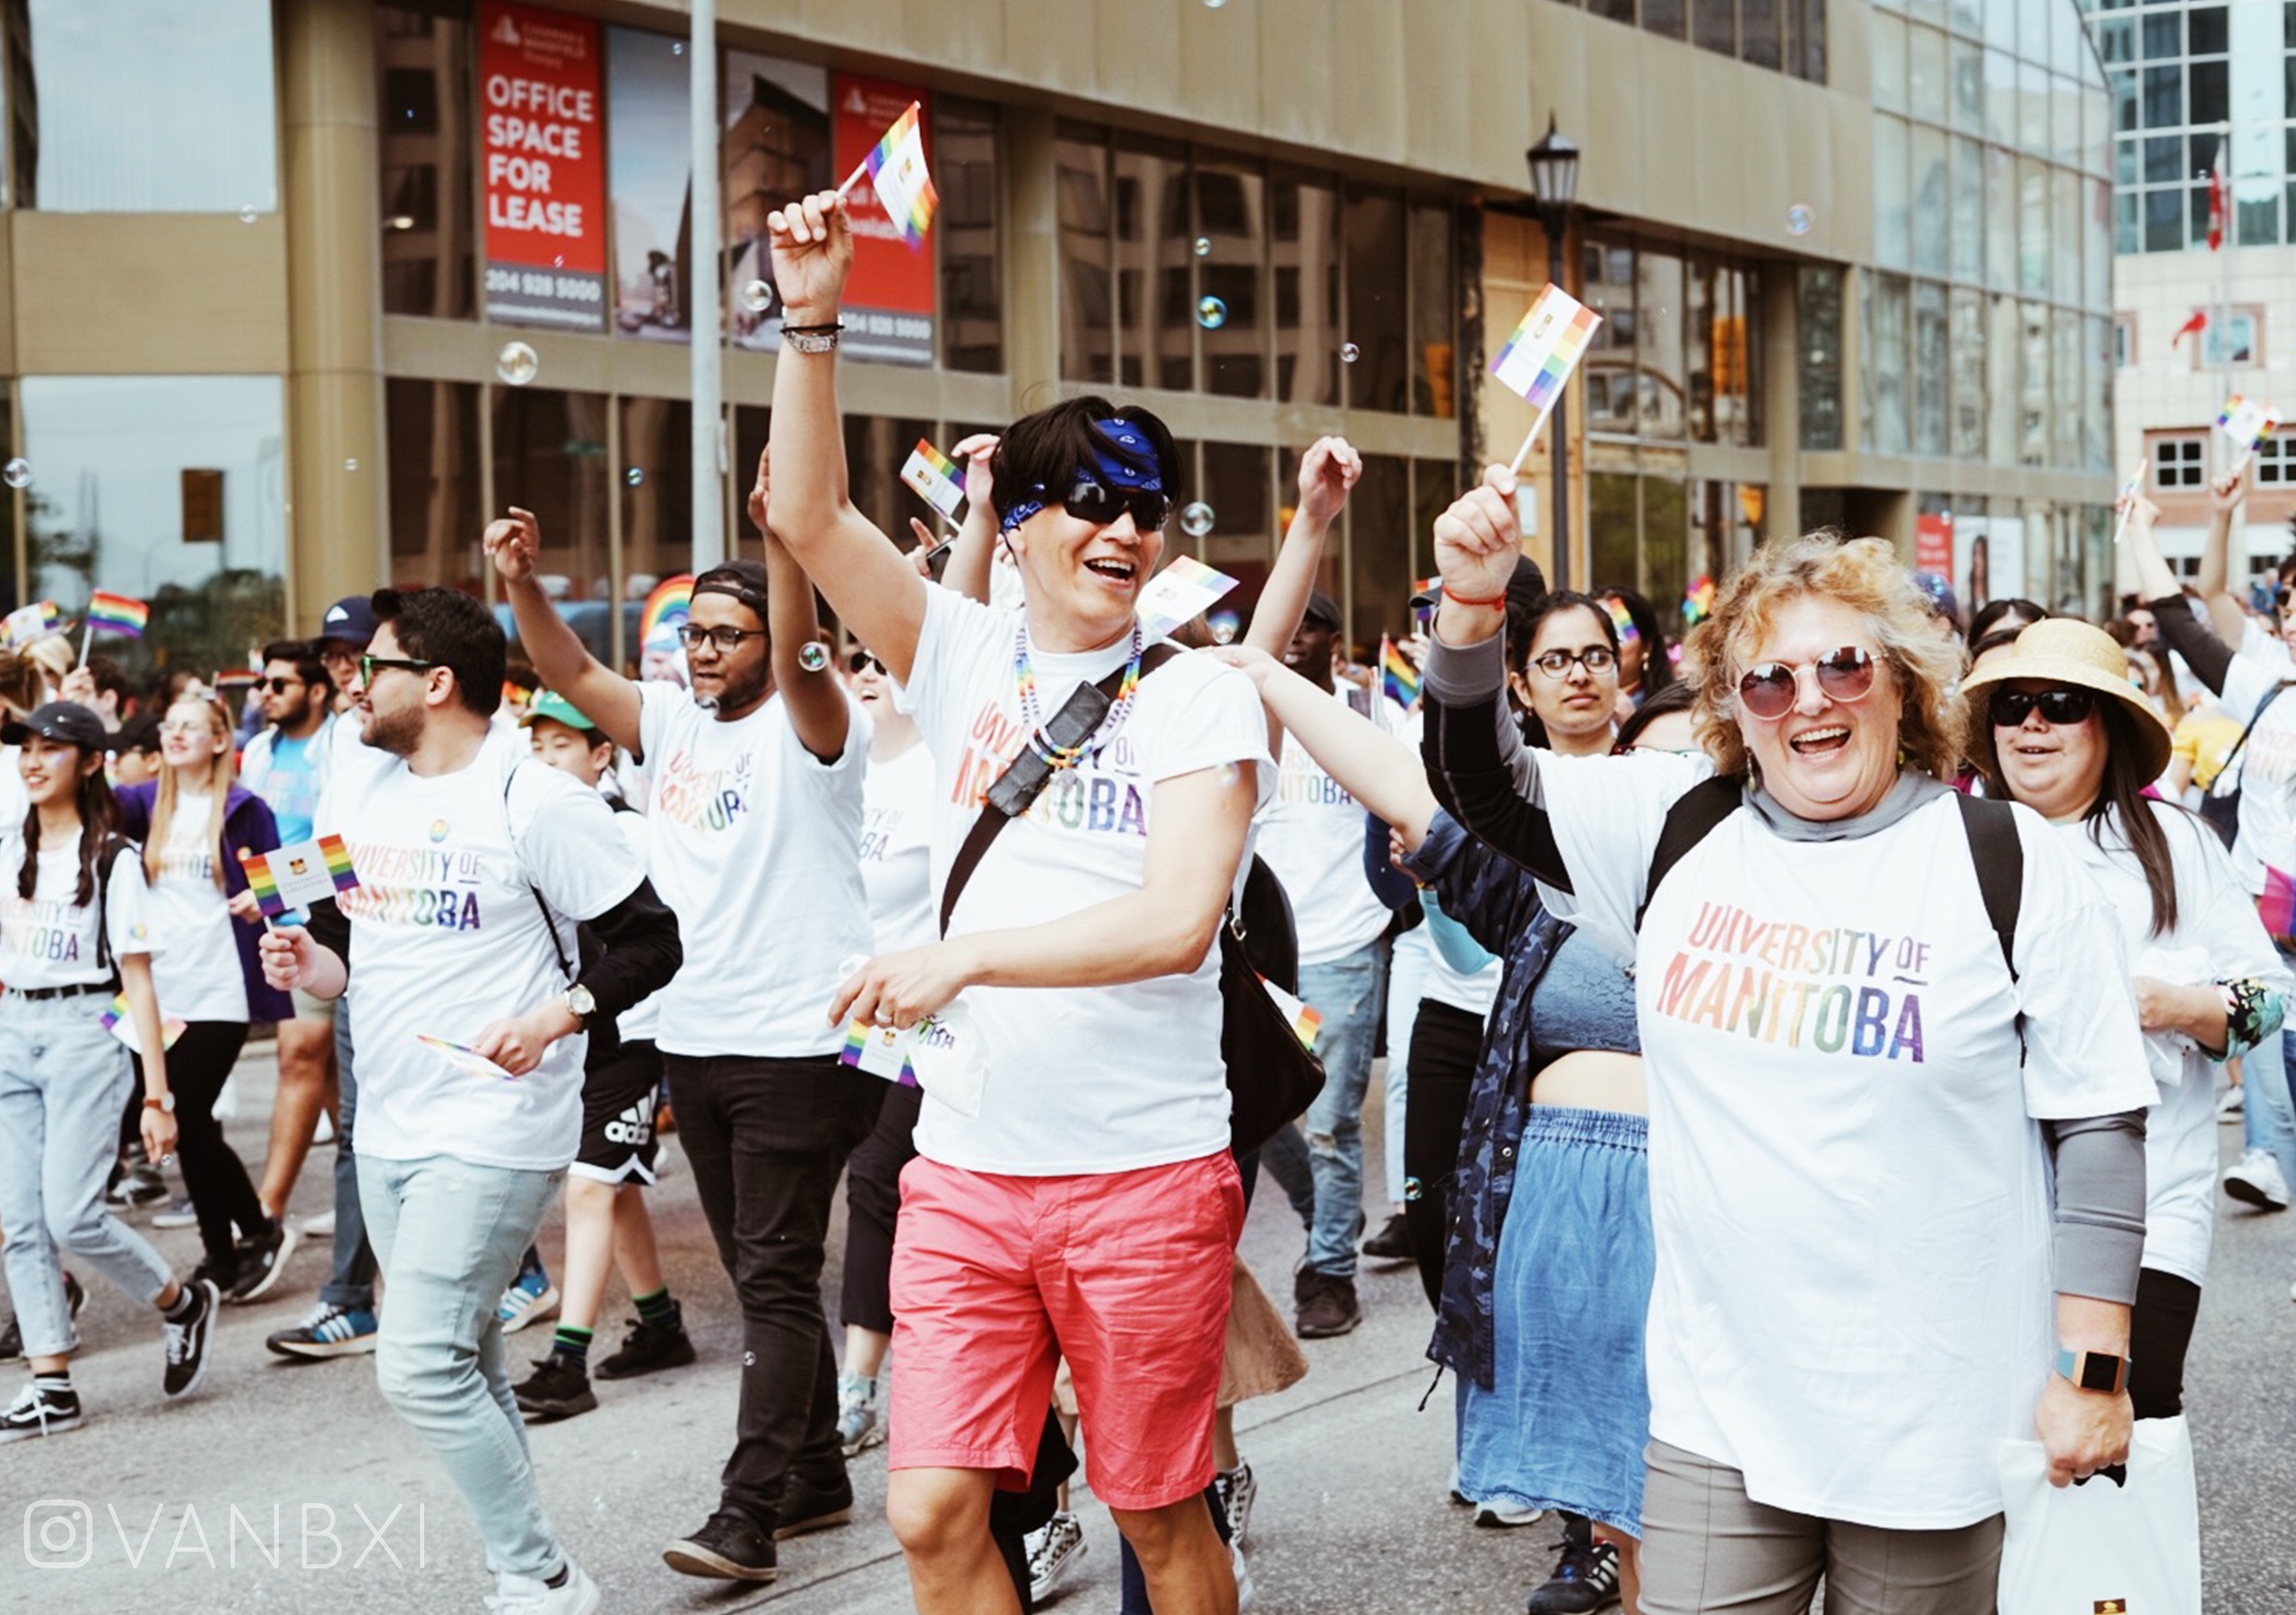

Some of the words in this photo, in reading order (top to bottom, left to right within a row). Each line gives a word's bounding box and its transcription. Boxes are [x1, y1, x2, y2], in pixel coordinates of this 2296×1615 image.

[486, 74, 594, 123] OFFICE
[487, 114, 581, 161] SPACE
[488, 152, 552, 195] FOR
[489, 194, 584, 239] LEASE
[485, 268, 520, 293] 204
[458, 853, 485, 876] OF
[1896, 936, 1932, 974] OF
[1656, 951, 1926, 1064] MANITOBA
